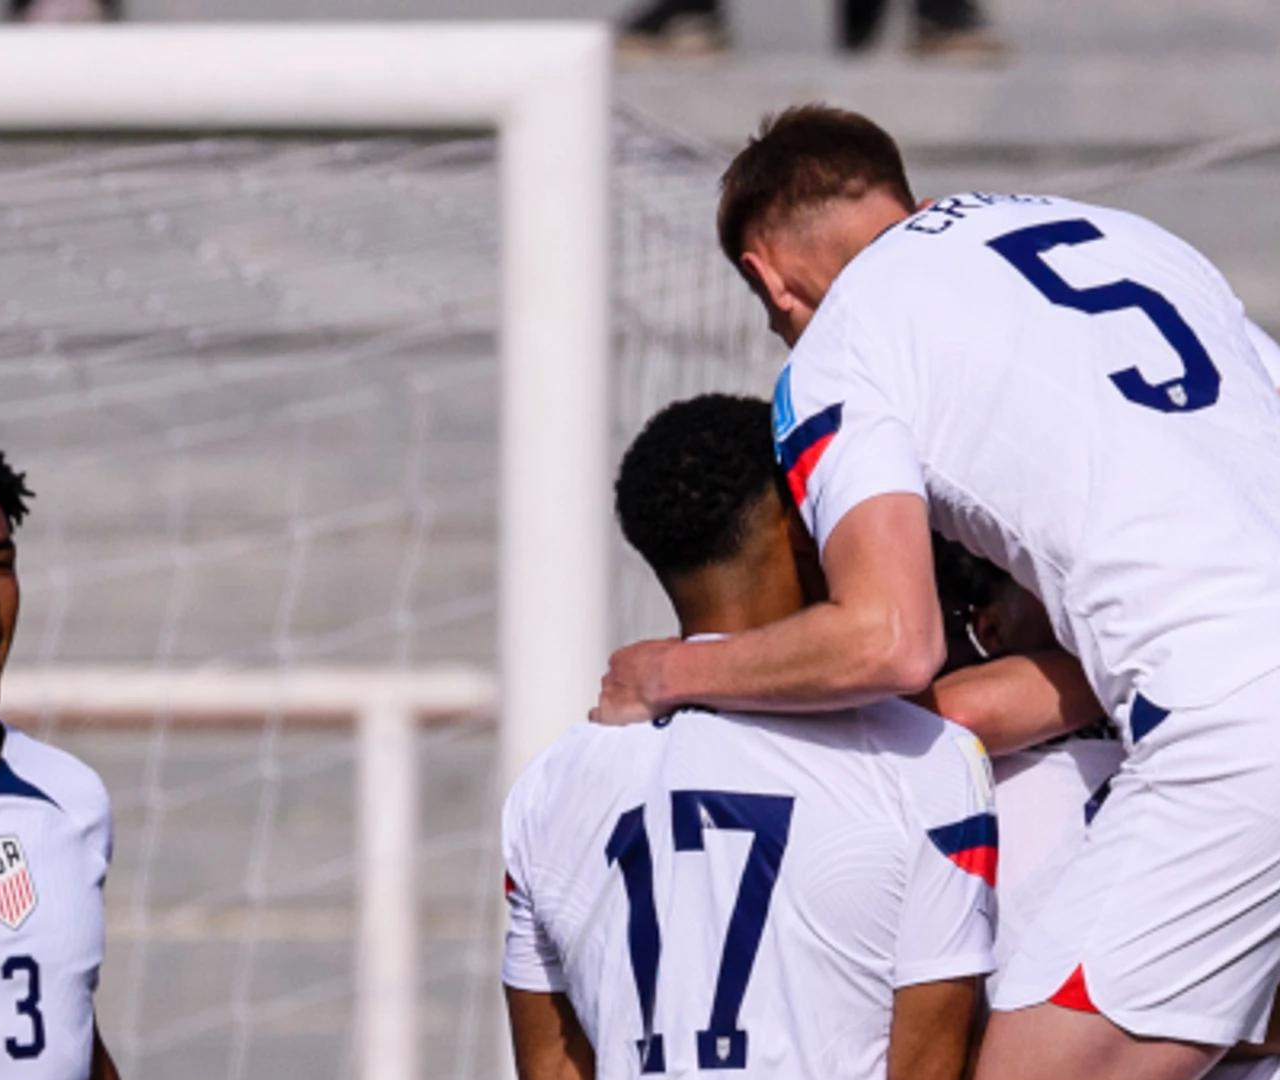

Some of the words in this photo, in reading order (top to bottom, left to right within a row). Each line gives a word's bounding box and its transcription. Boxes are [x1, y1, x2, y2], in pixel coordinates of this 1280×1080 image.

[985, 218, 1222, 413] 5
[0, 954, 46, 1060] 3
[605, 790, 795, 1075] 17
